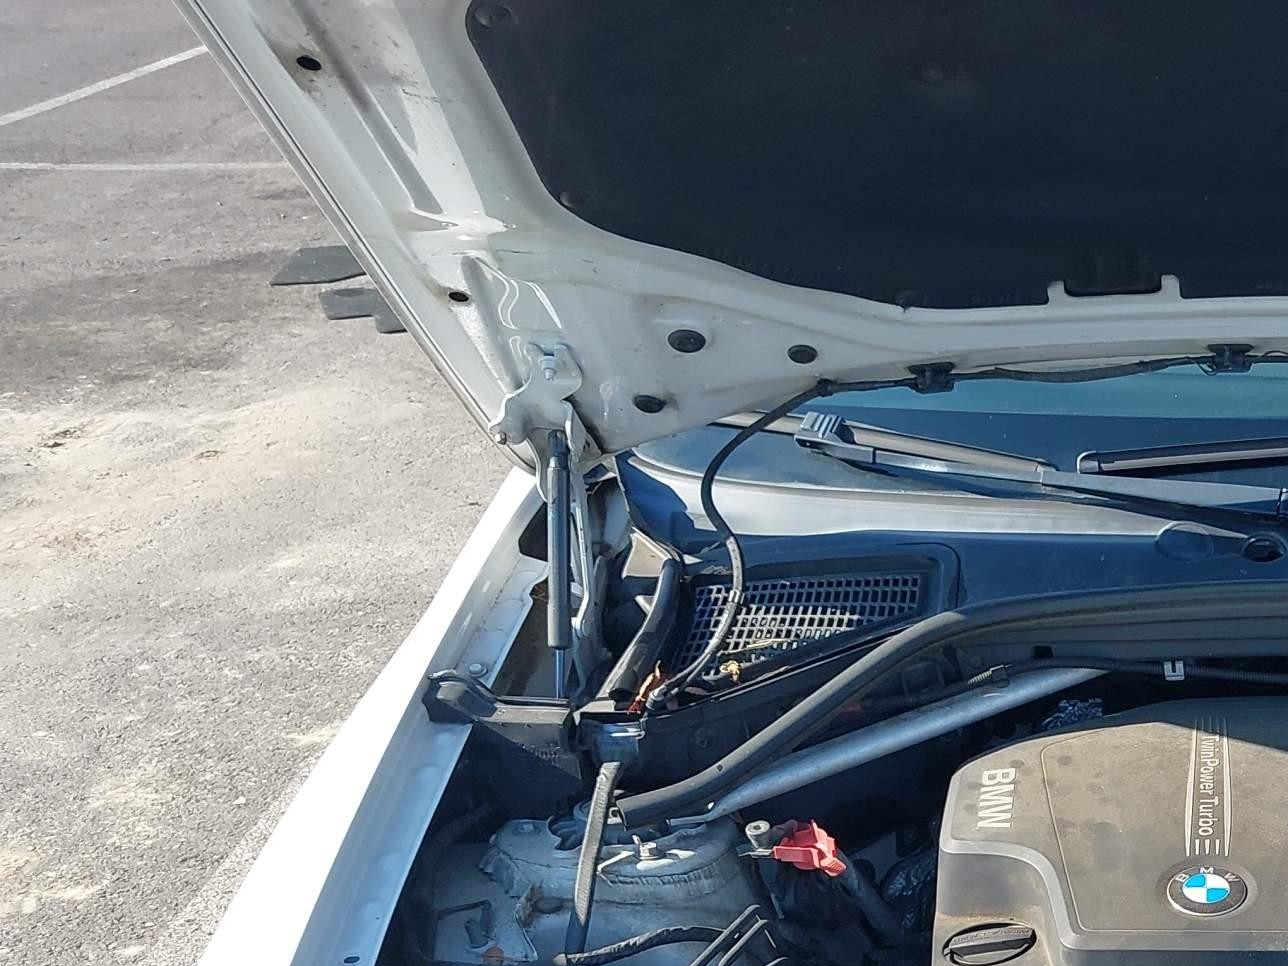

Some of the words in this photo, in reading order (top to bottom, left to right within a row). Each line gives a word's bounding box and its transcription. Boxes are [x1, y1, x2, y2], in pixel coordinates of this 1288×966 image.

[1199, 734, 1220, 795] TwinPower
[976, 767, 1017, 829] BMW
[1198, 796, 1220, 837] Turbo
[1175, 866, 1240, 883] BMW
